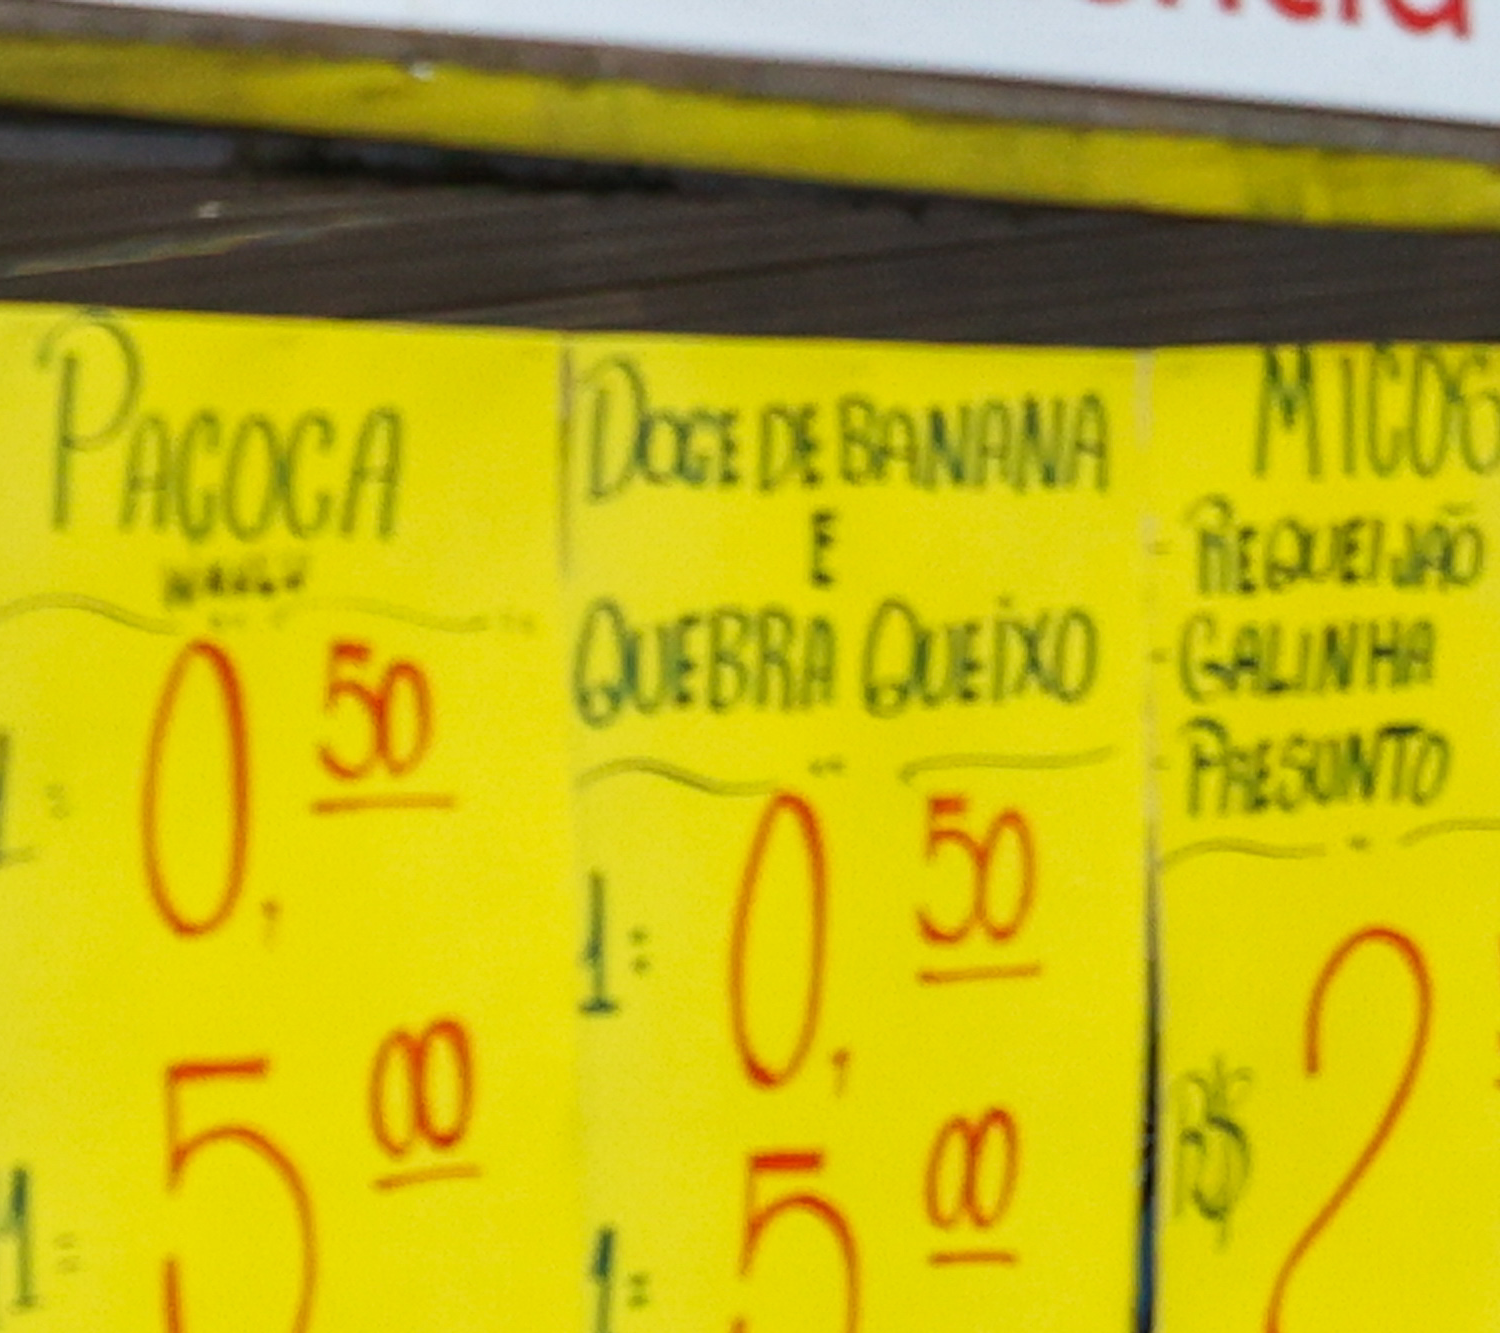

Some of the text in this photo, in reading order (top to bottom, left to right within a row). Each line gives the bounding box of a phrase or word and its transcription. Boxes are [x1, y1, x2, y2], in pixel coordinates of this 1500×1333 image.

[573, 354, 1114, 506] DOCE DE BANANA
[807, 508, 836, 588] E
[573, 592, 1102, 730] QUEBRA QUEIXO
[1176, 612, 1440, 706] GALINHA
[1178, 716, 1452, 820] PRESUNTO
